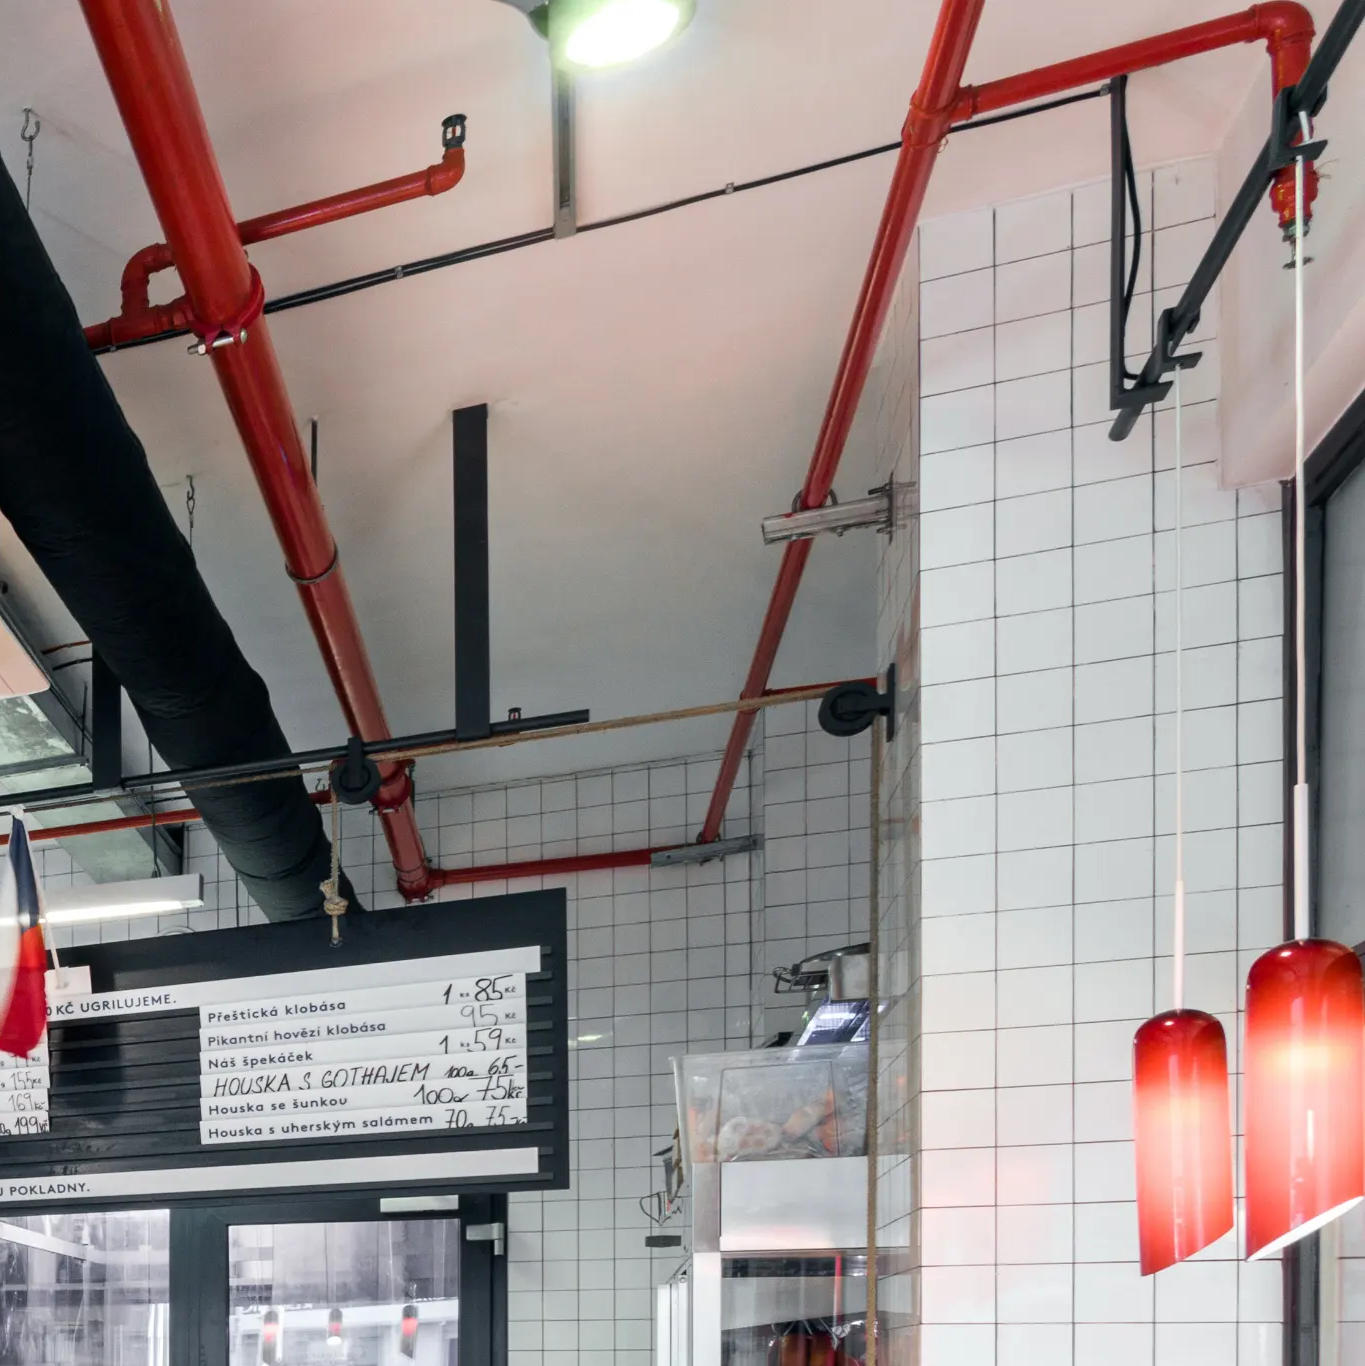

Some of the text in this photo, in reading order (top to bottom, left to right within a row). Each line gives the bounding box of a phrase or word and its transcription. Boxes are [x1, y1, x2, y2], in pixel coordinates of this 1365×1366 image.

[56, 994, 177, 1015] KČ UGRILUJEME.
[208, 1006, 279, 1024] Přeštická
[285, 1001, 347, 1017] klobása
[443, 983, 453, 1005] 1
[474, 974, 514, 1002] 85
[208, 1032, 270, 1047] Pikantní
[274, 1027, 322, 1042] hovězí
[326, 1021, 386, 1036] klobása
[460, 1004, 499, 1027] 95
[209, 1057, 236, 1070] Náš
[242, 1050, 314, 1069] špekáček
[439, 1035, 449, 1055] 1
[474, 1028, 503, 1051] 59
[213, 1063, 431, 1098] HOUSKA S GOTHAJEM
[8, 1093, 32, 1112] 169
[209, 1096, 348, 1116] Houska se šunkou
[14, 1116, 39, 1135] 199
[209, 1115, 433, 1139] Houska s uherským salámem
[9, 1182, 91, 1196] POKLADNY.
